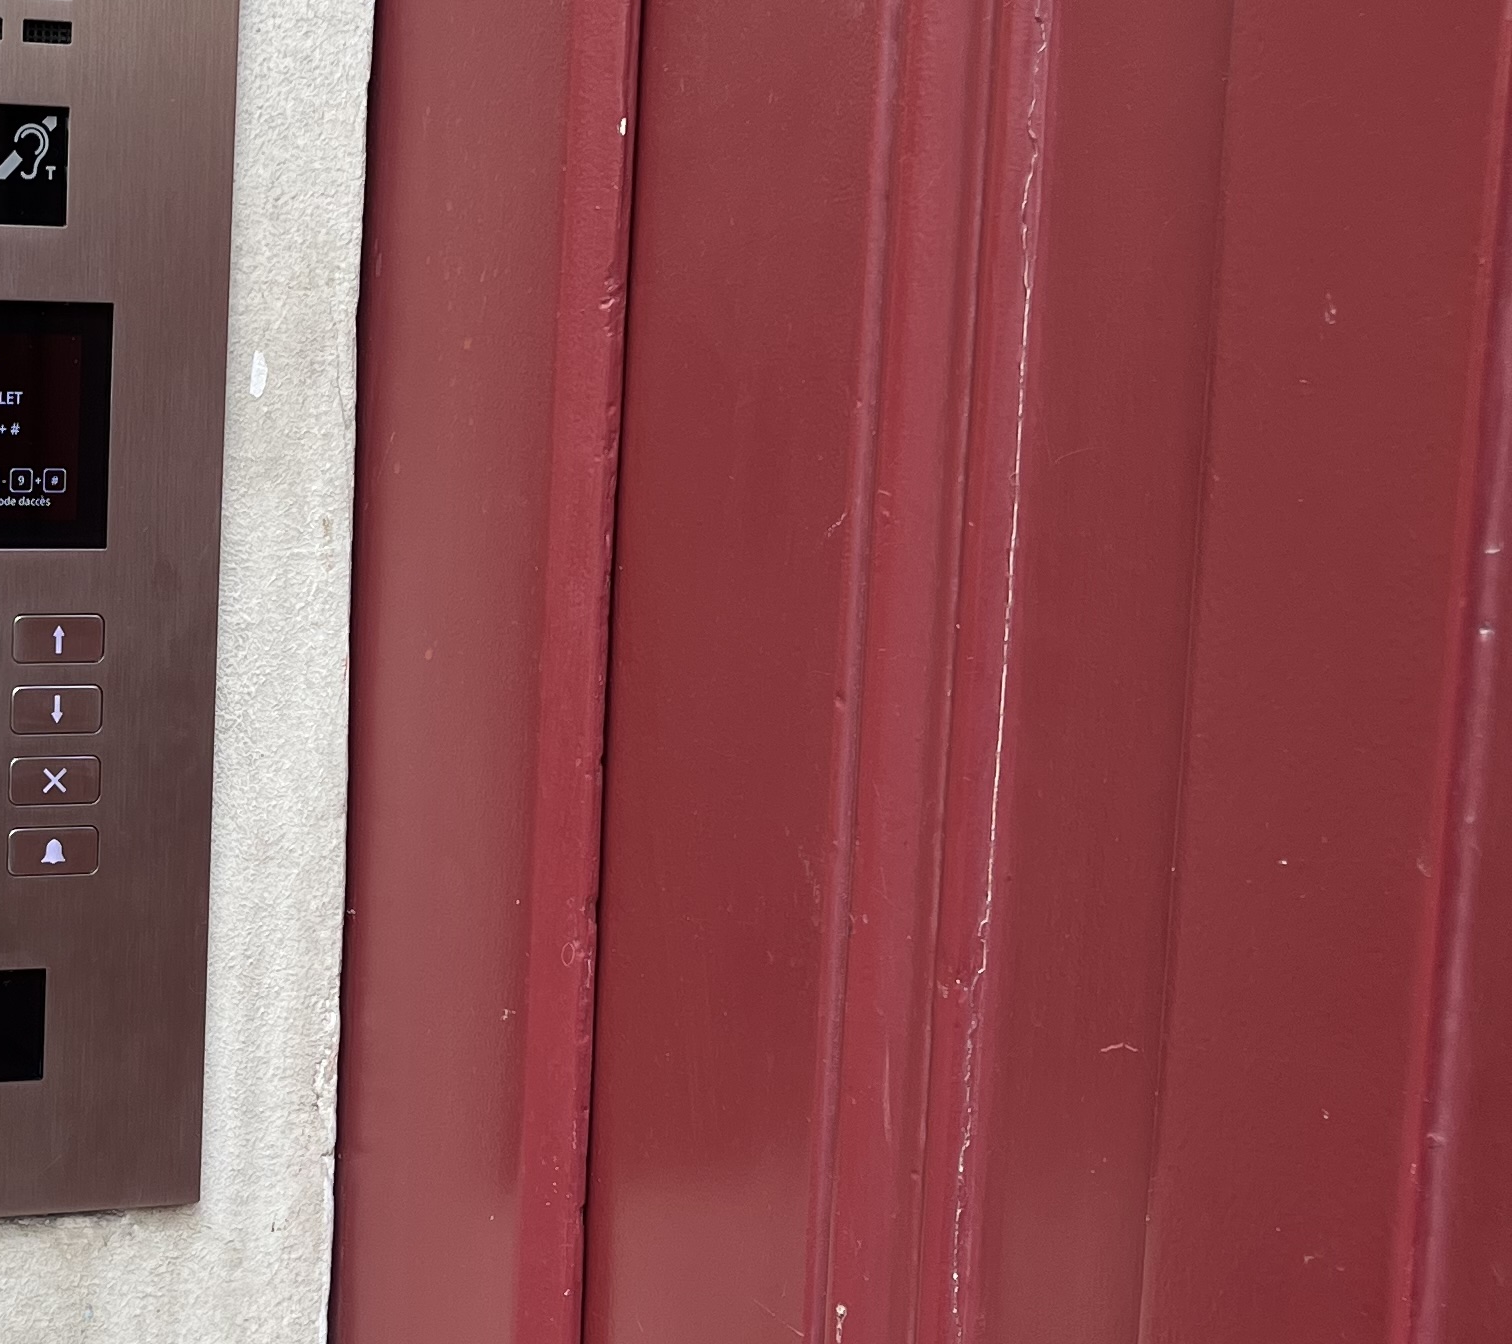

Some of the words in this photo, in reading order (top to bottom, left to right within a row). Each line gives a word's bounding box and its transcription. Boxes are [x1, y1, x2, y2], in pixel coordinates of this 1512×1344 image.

[45, 166, 56, 181] T
[10, 422, 21, 436] #
[18, 475, 25, 486] 9
